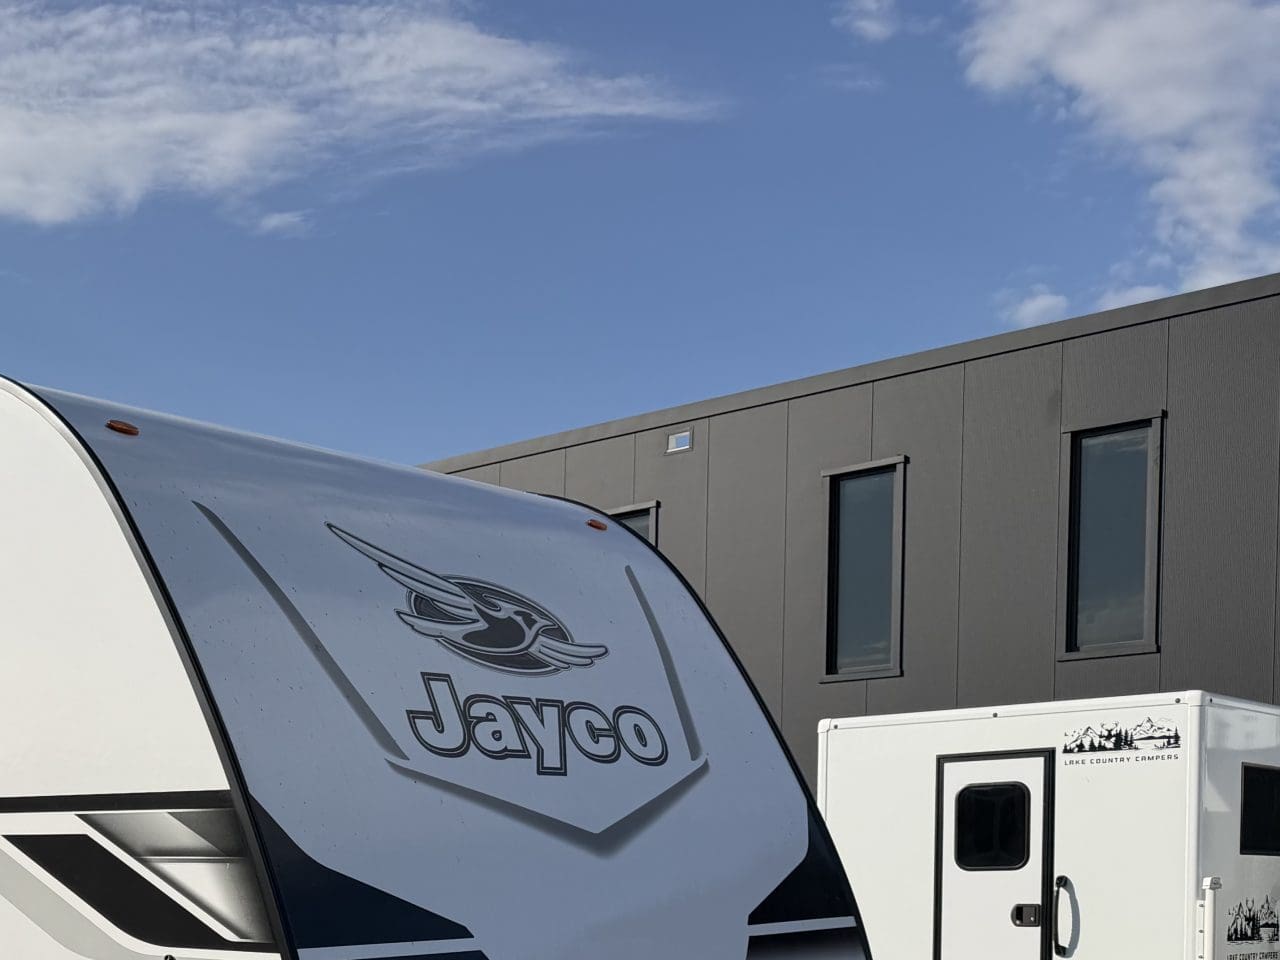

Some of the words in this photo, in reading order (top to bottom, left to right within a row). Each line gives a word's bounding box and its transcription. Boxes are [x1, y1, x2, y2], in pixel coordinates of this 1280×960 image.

[405, 671, 668, 776] Jayco
[1064, 758, 1086, 766] LAKE
[1090, 756, 1131, 764] COUNTRY
[1135, 754, 1179, 762] CAMPERS
